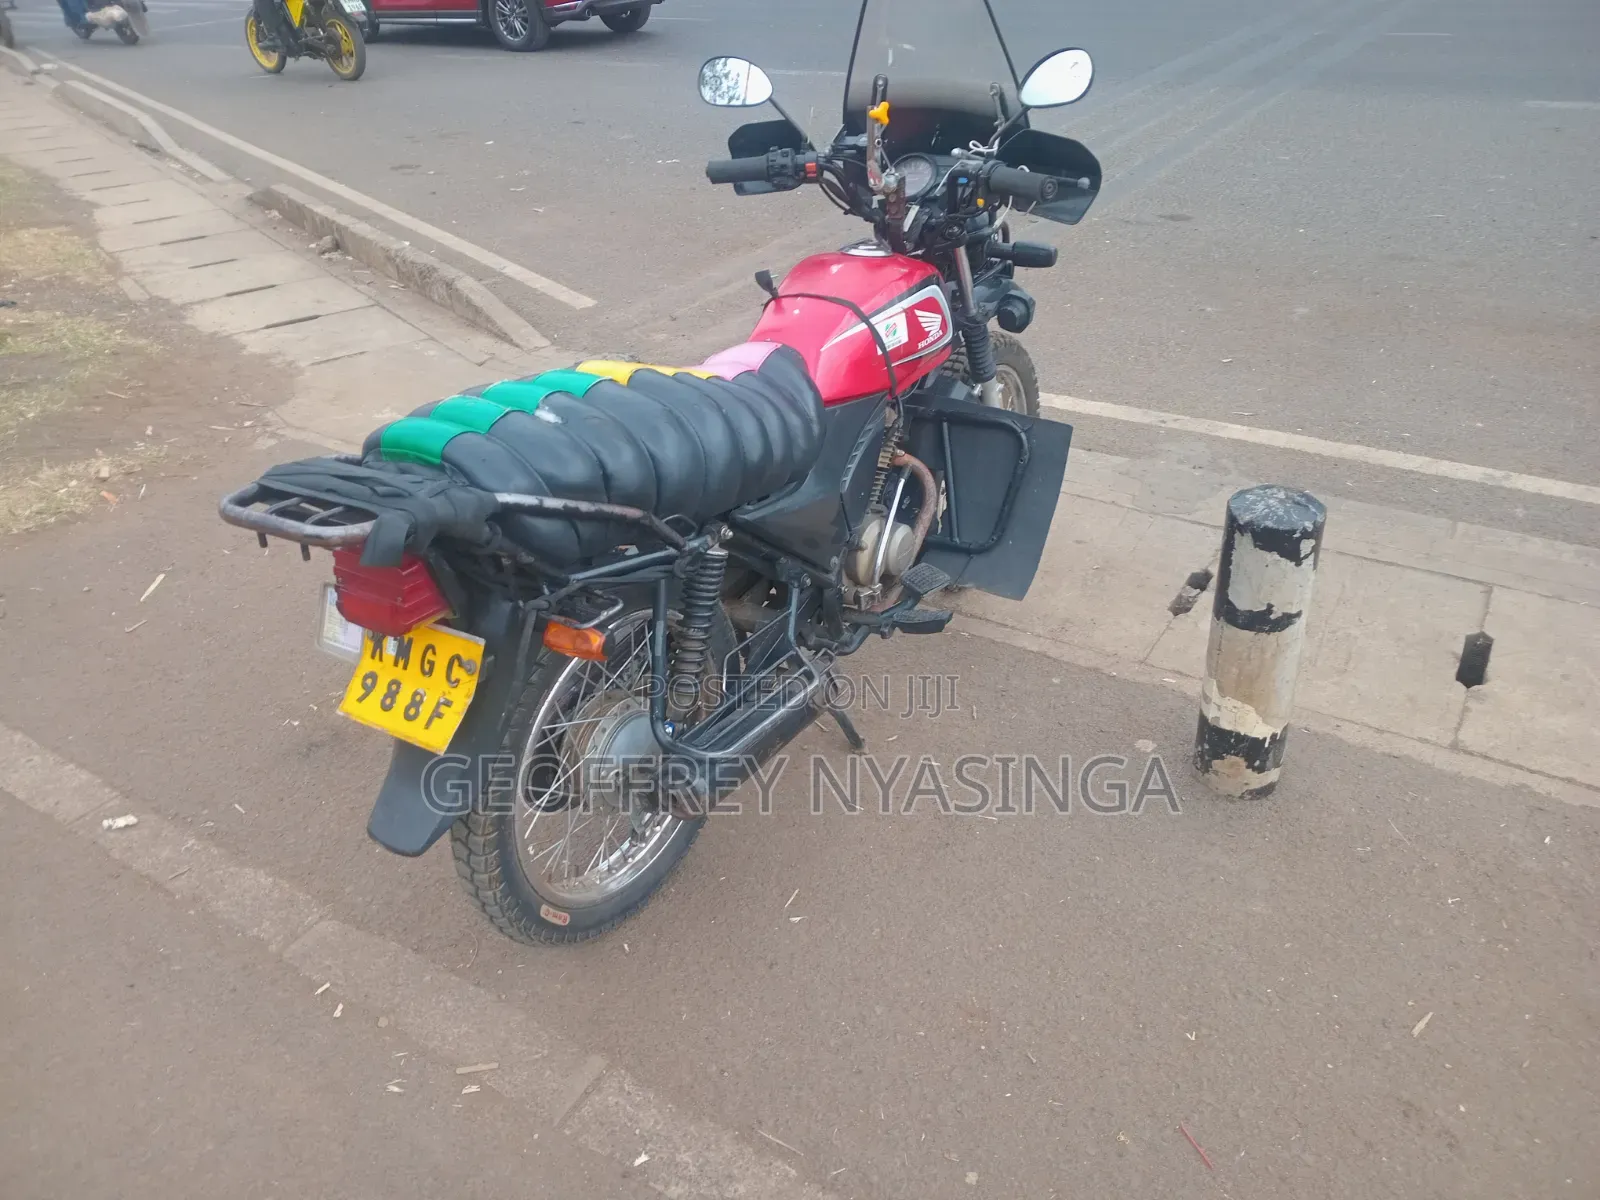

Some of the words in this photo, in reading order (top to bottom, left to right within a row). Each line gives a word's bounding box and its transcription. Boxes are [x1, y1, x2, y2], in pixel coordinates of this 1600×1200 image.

[917, 330, 943, 349] HONDA
[369, 633, 461, 688] KMGC
[356, 671, 453, 729] 988F
